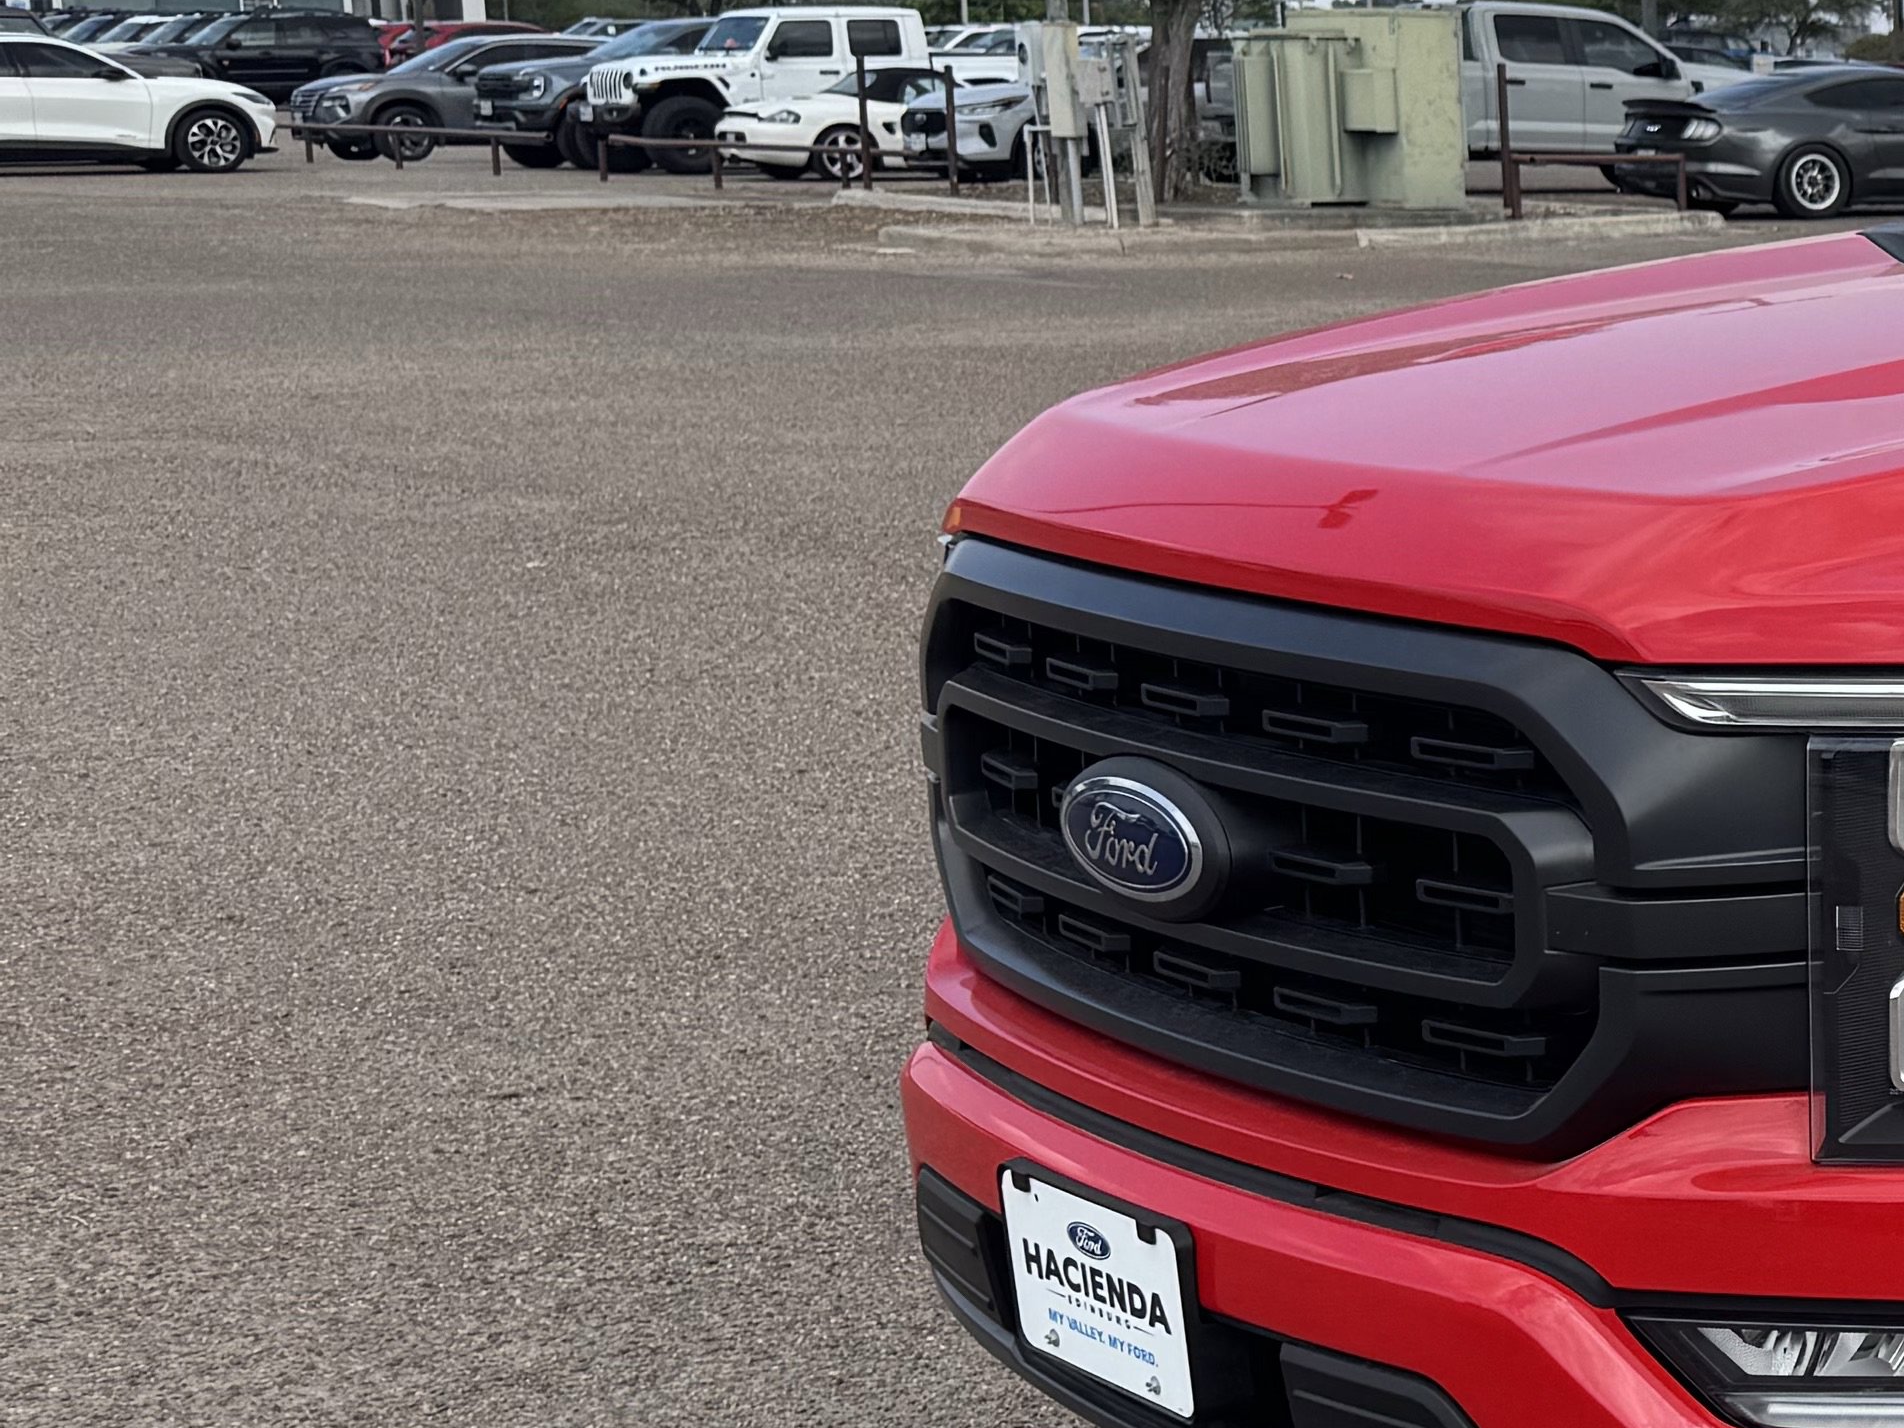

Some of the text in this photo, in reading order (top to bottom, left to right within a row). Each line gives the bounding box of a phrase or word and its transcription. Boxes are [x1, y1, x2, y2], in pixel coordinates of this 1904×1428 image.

[1084, 800, 1160, 876] Ford
[1075, 1227, 1102, 1255] Ford
[1022, 1237, 1173, 1336] HACIENDA
[1048, 1307, 1065, 1326] MY
[1107, 1334, 1127, 1353] MY
